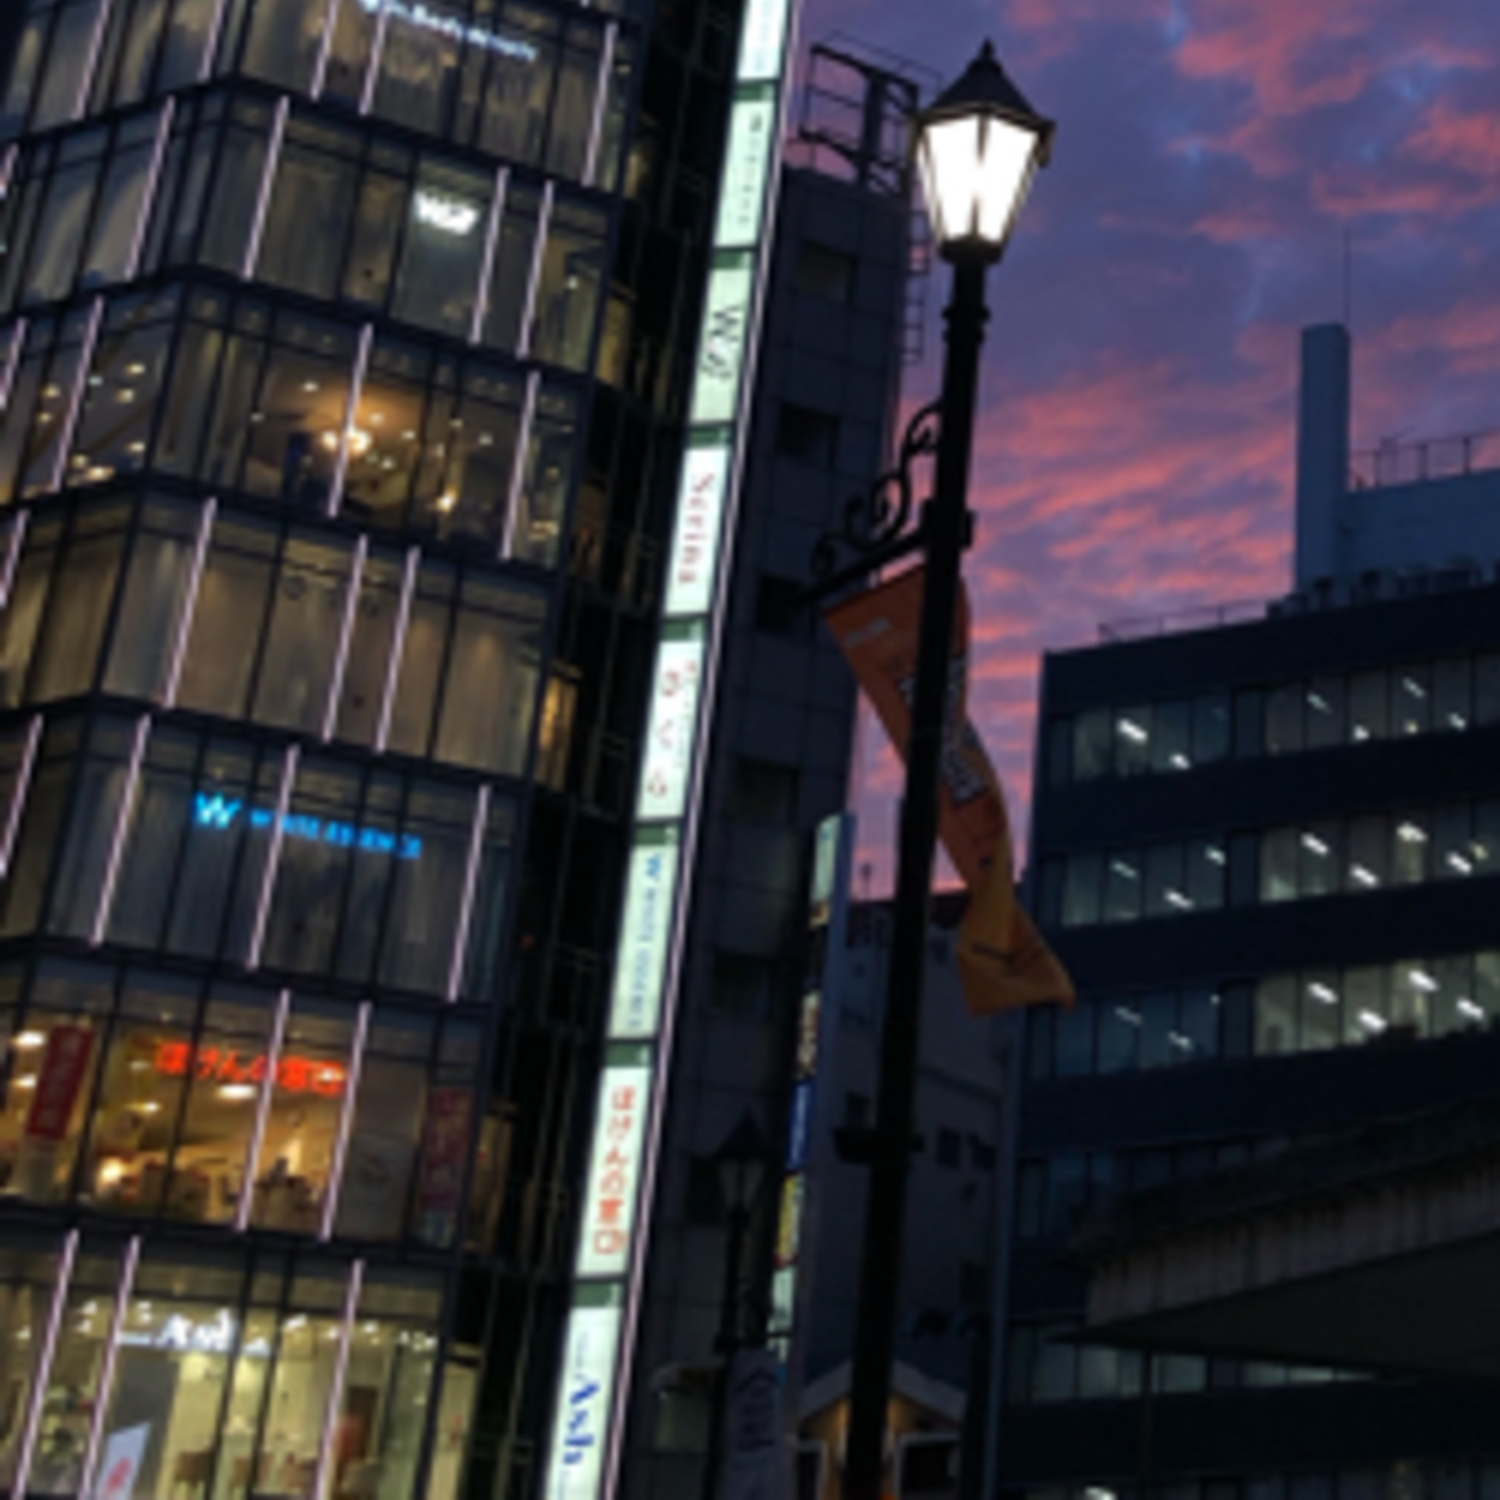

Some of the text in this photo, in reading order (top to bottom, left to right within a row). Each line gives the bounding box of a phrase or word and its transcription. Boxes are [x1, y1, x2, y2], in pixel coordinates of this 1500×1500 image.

[593, 1084, 638, 1255] ほけんの窓口
